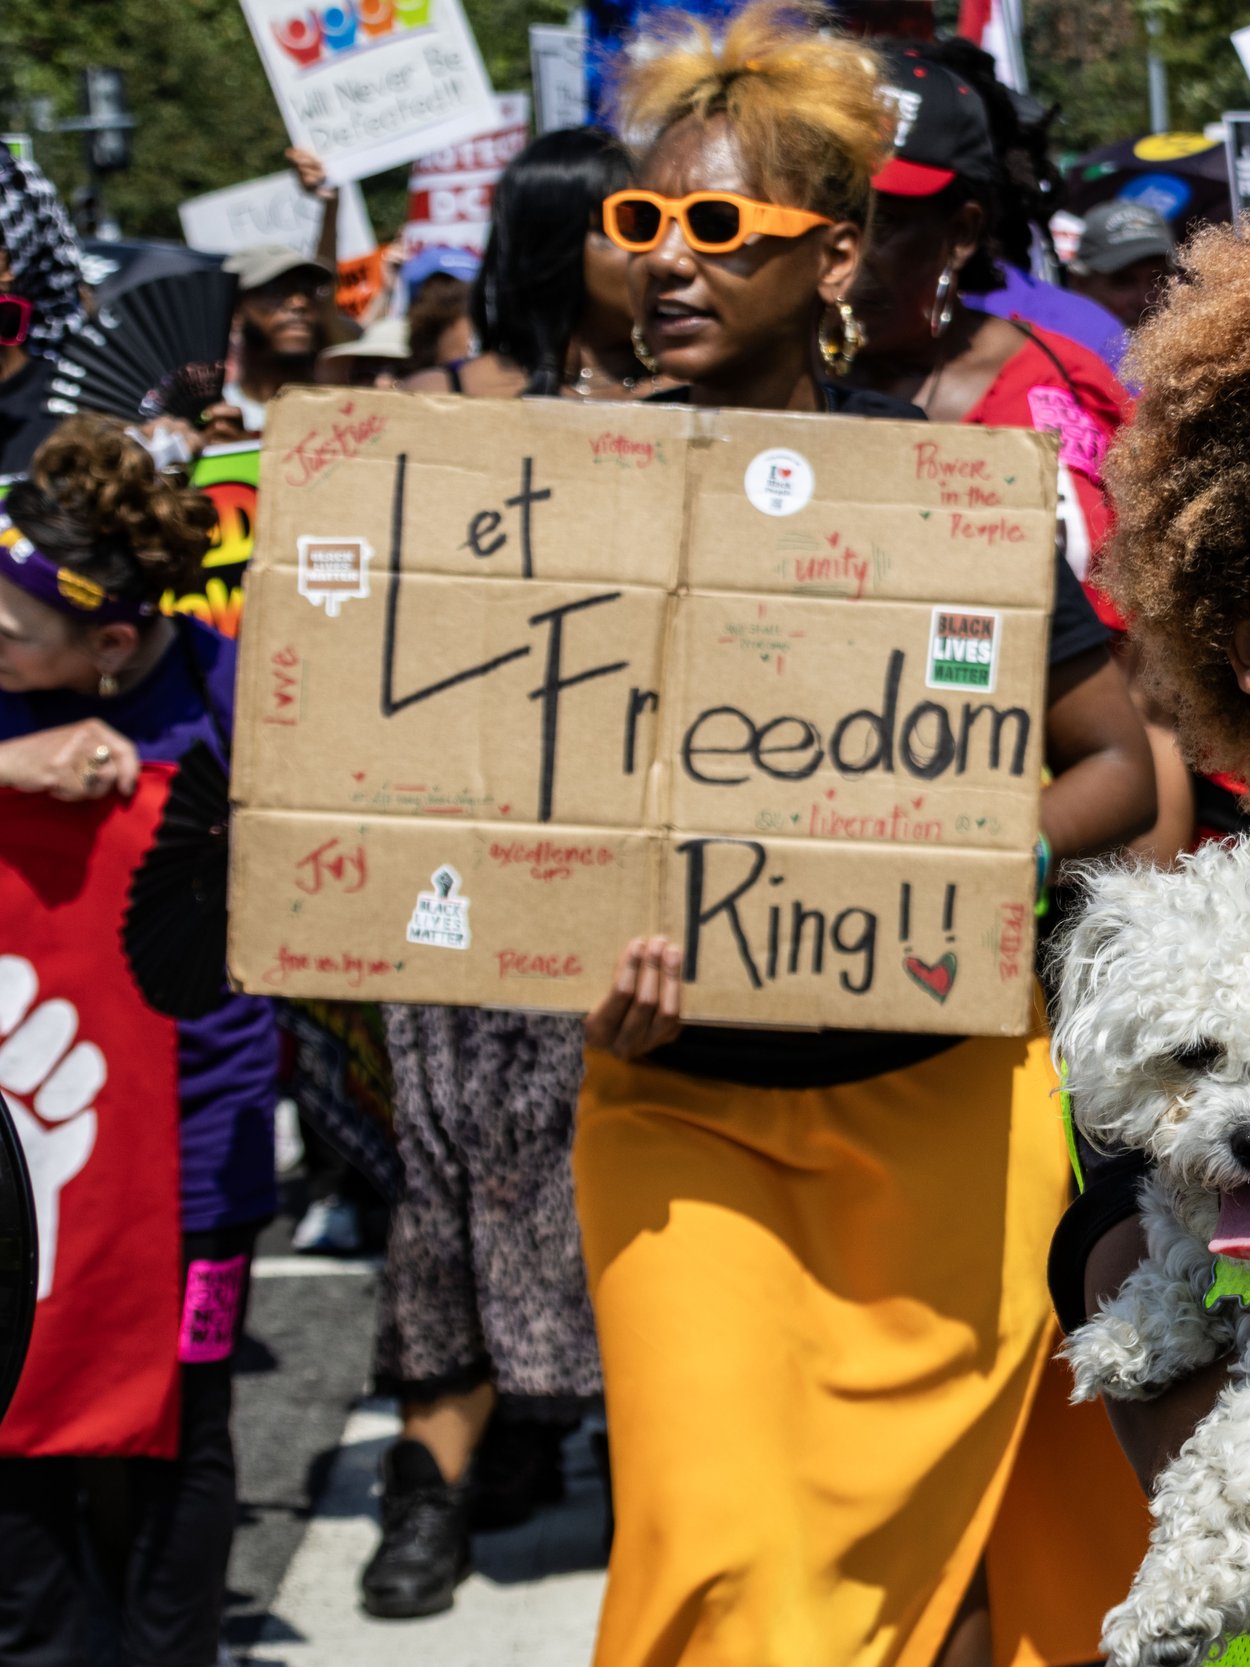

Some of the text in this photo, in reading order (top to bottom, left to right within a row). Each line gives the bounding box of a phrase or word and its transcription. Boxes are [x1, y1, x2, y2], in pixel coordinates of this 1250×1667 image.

[939, 480, 1002, 508] in the
[951, 513, 1025, 546] People
[381, 453, 552, 718] Let
[938, 614, 992, 635] BLACK
[932, 637, 992, 664] LIVES
[934, 665, 990, 686] MATTER
[528, 592, 1030, 823] Freedom
[294, 837, 368, 895] Joy
[414, 912, 463, 931] LIVES
[419, 899, 461, 918] BLACK
[409, 927, 464, 946] MATTER
